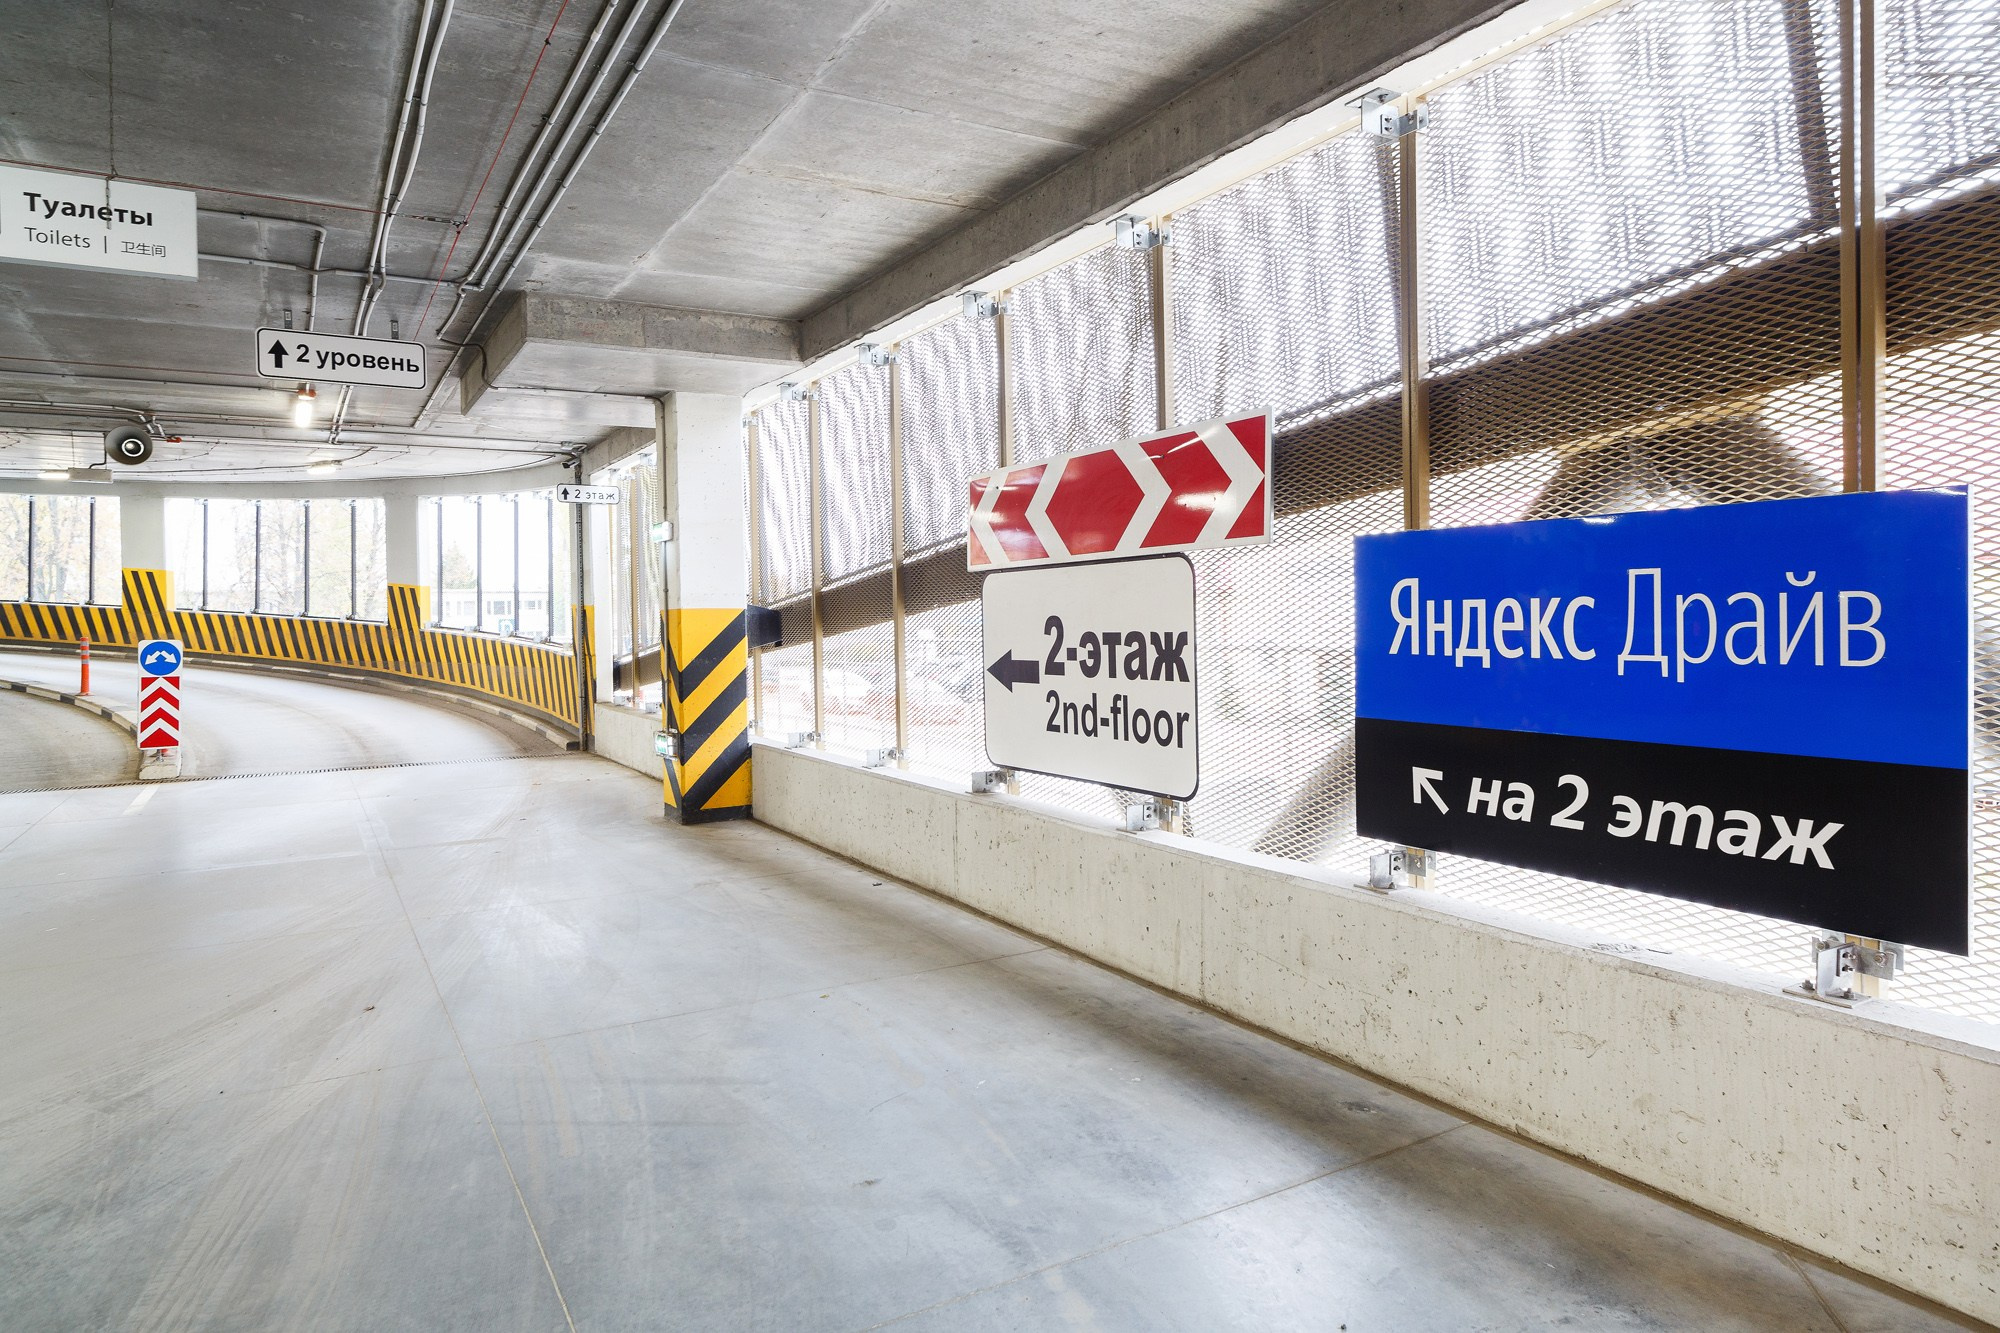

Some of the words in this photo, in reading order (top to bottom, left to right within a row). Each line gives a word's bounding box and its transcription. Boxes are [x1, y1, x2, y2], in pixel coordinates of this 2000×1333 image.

[23, 191, 153, 226] Туалеты
[24, 226, 91, 248] Toilets
[121, 240, 167, 257] 卫生间
[296, 343, 310, 364] 2
[316, 350, 418, 372] уровень
[574, 488, 581, 499] 2
[585, 491, 615, 500] этаж
[1389, 577, 1596, 669] Яндекс
[1617, 568, 1887, 683] Драйв
[1044, 615, 1191, 683] 2-этаж
[1046, 689, 1191, 749] 2nd-floor
[1466, 777, 1535, 823] на
[1550, 774, 1590, 831] 2
[1607, 794, 1845, 870] этаж
